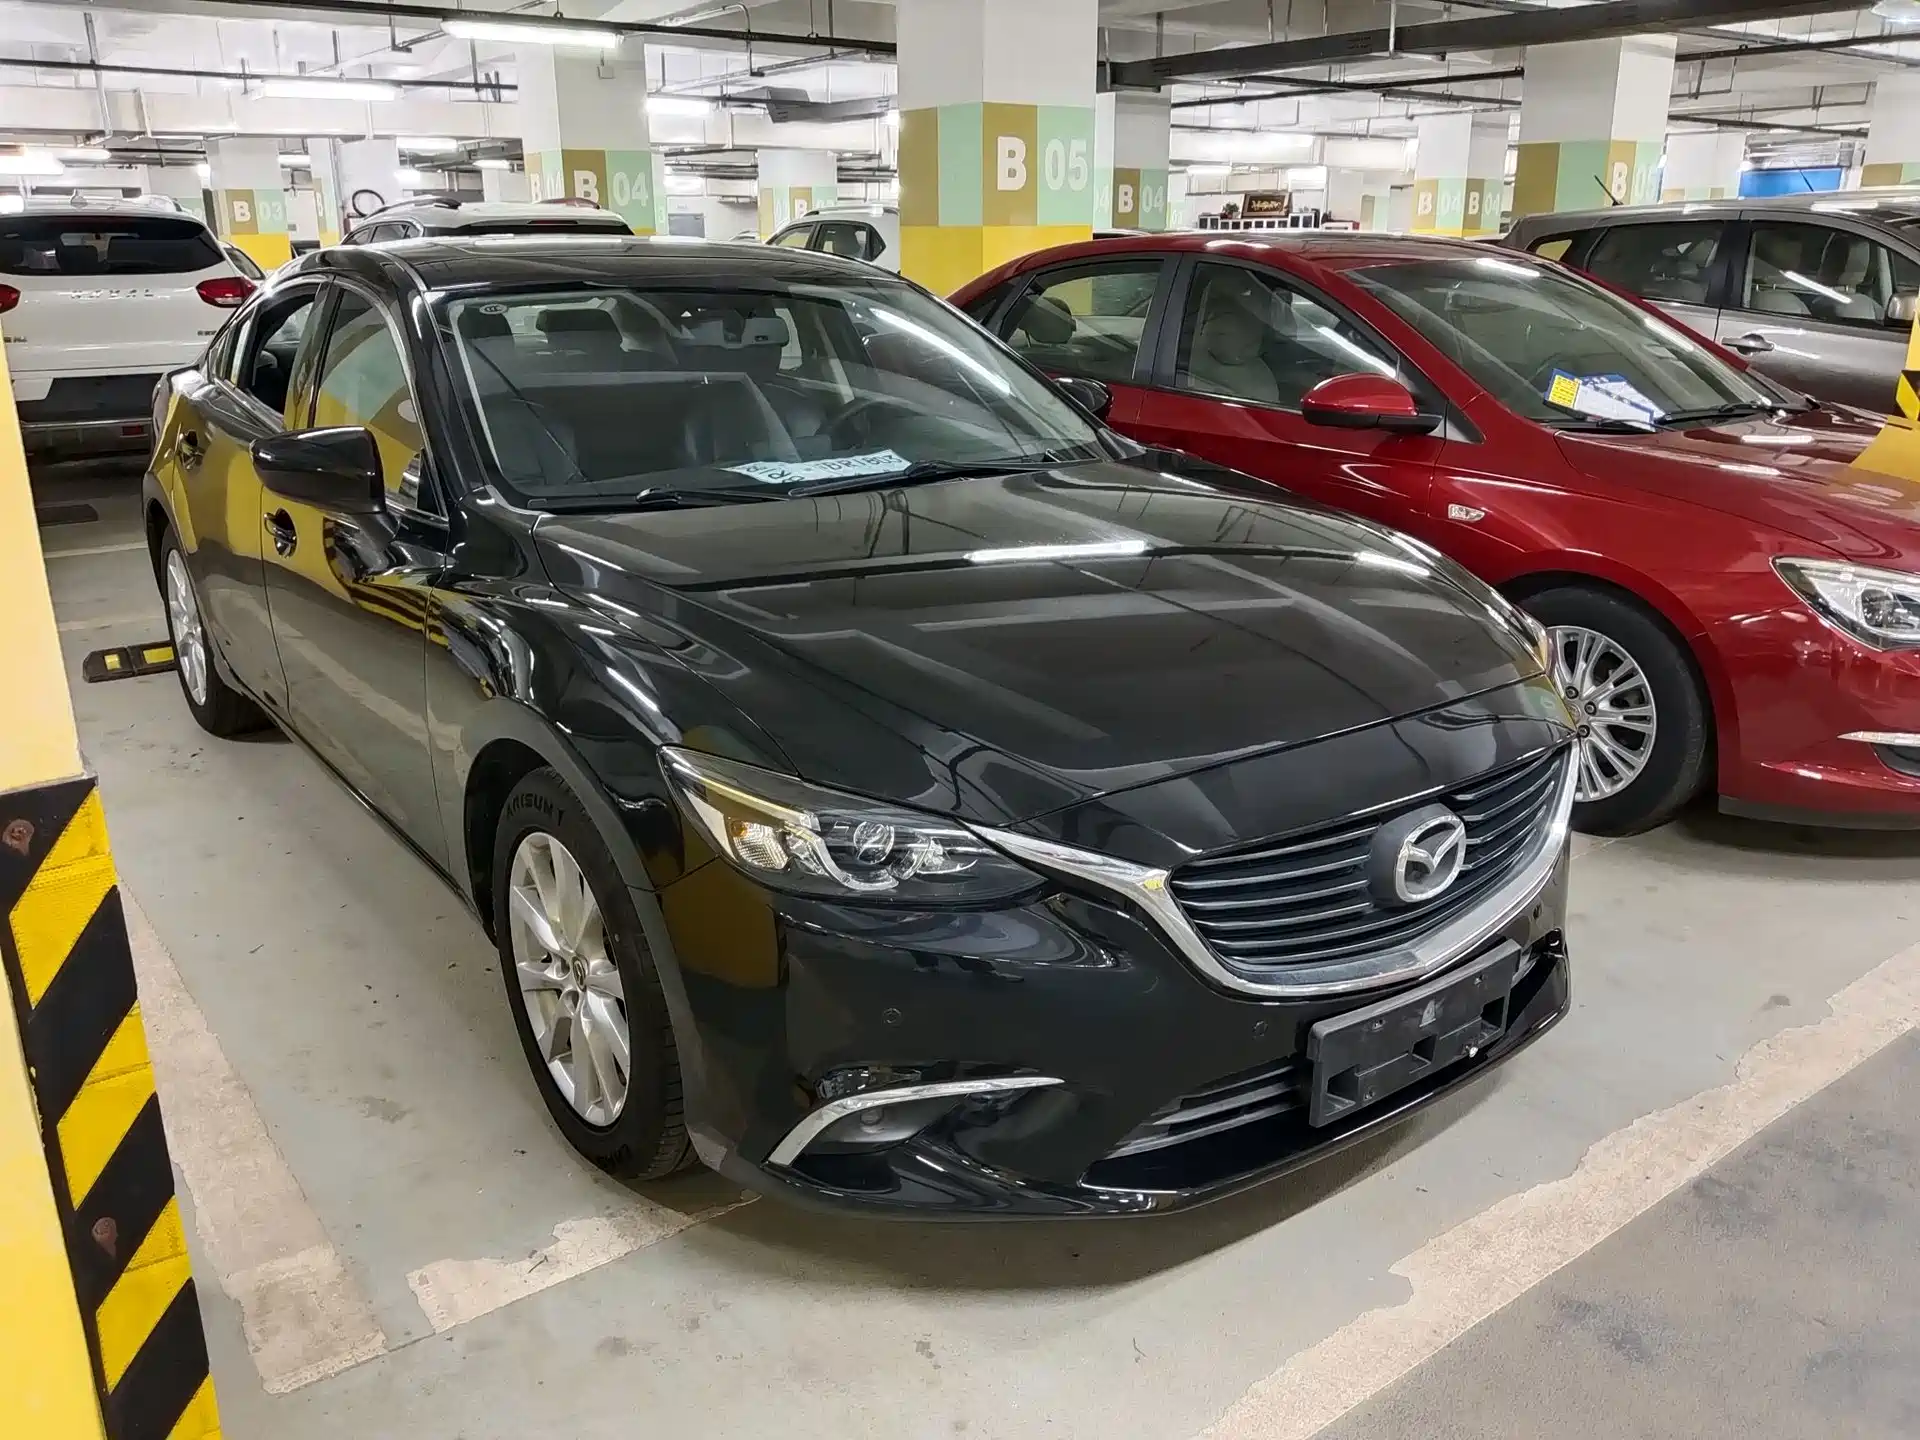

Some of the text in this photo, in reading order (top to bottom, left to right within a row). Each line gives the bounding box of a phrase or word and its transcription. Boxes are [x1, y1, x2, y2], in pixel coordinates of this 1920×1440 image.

[997, 136, 1088, 191] B 05
[574, 170, 649, 207] B 04
[1612, 161, 1628, 200] B
[232, 200, 282, 222] B 03
[1118, 184, 1164, 213] B 04
[1417, 191, 1433, 216] B
[1468, 191, 1501, 216] B 04
